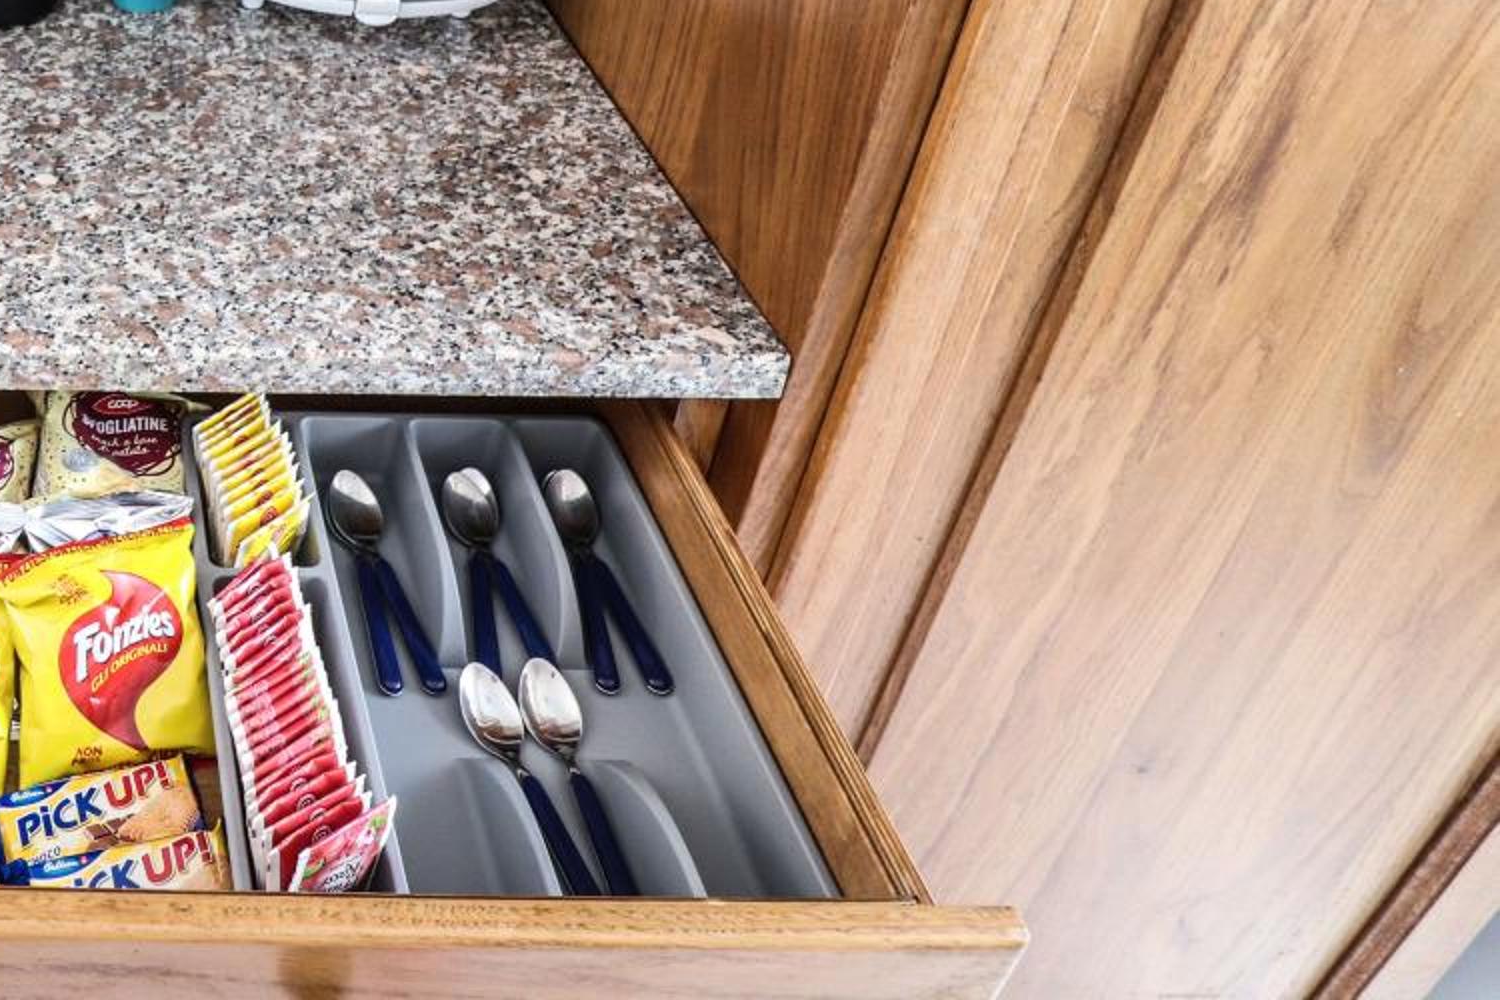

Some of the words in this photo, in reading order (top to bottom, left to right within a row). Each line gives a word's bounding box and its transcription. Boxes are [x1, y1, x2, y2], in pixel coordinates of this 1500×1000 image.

[73, 604, 176, 684] Fonzies
[103, 761, 172, 810] UP!
[141, 831, 214, 884] UP!
